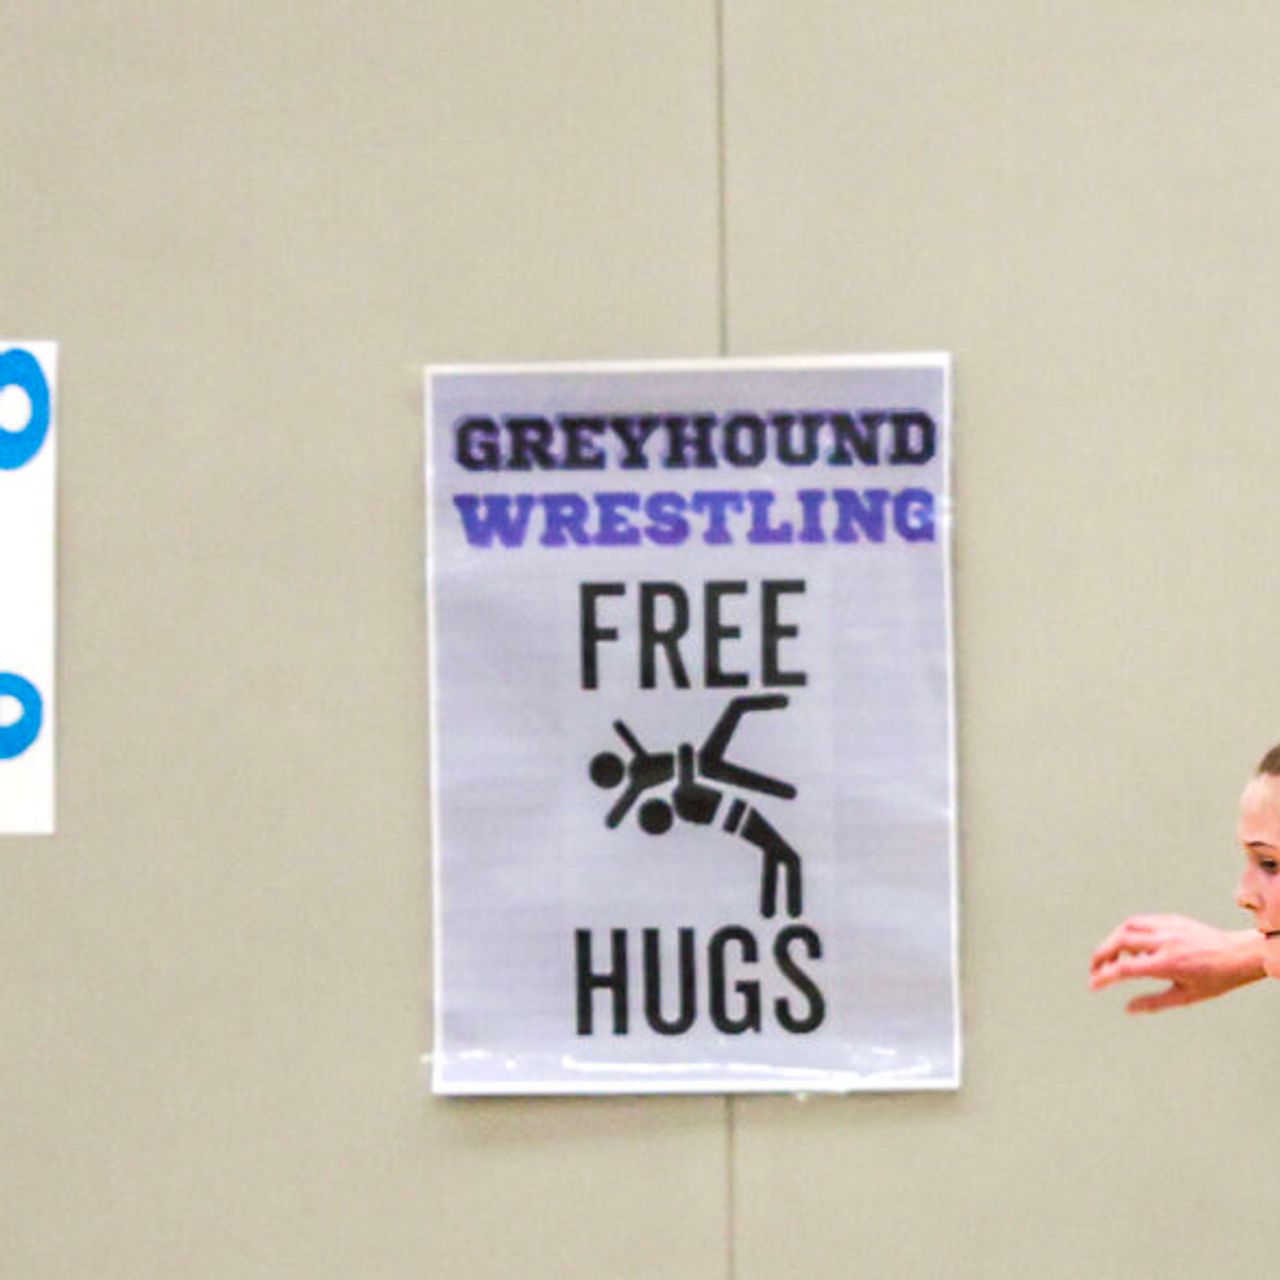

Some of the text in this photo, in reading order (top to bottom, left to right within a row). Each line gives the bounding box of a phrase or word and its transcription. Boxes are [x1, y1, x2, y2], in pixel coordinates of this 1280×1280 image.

[453, 409, 937, 474] GREYHOUND
[453, 488, 937, 549] WRESTLING
[578, 578, 808, 690] FREE
[574, 925, 826, 1037] HUGS
